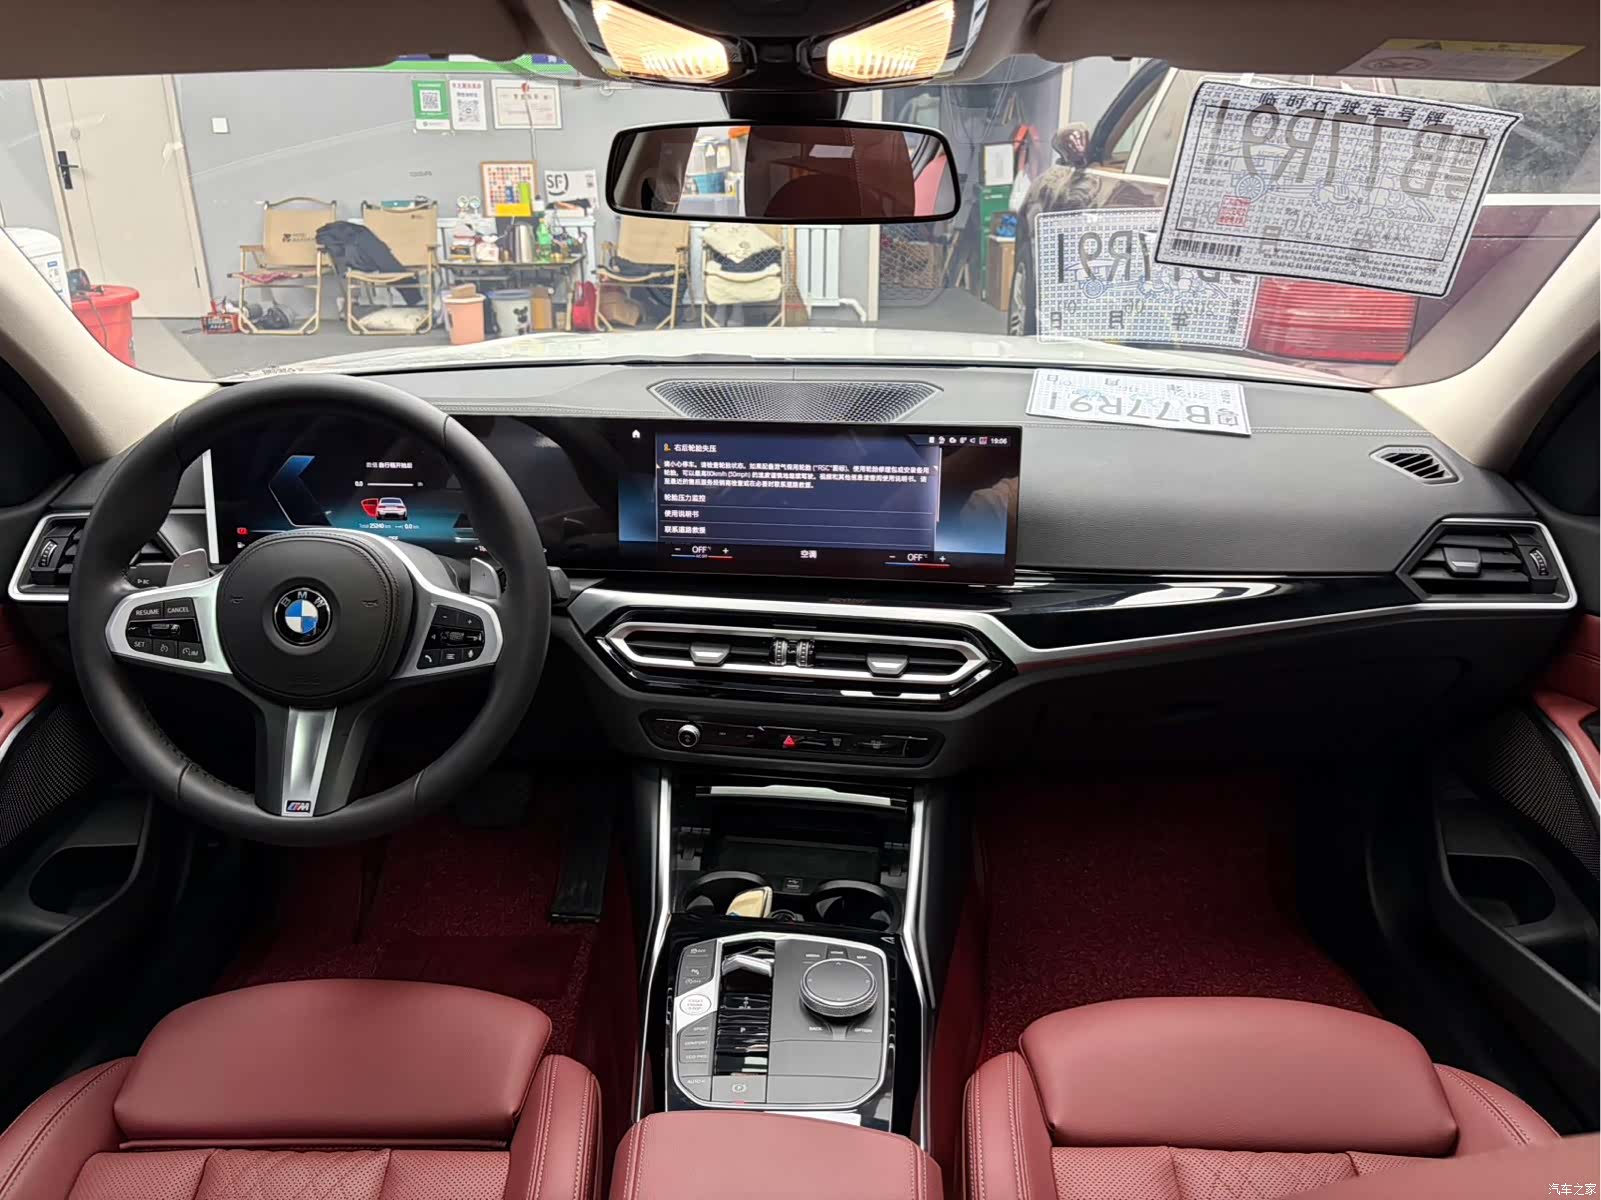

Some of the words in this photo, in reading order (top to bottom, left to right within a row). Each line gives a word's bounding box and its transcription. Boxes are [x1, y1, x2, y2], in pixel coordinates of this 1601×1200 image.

[1259, 92, 1447, 125] 临时行驶车号牌
[990, 437, 1008, 445] 19:06
[674, 443, 717, 453] 右后轮胎失压
[664, 493, 706, 503] 轮胎压力监控
[664, 510, 699, 518] 使用说明书
[664, 525, 706, 535] 联系道路救援
[800, 549, 817, 559] 空调
[281, 591, 326, 608] BMW
[135, 608, 160, 616] RESUME
[167, 606, 190, 614] CANCEL
